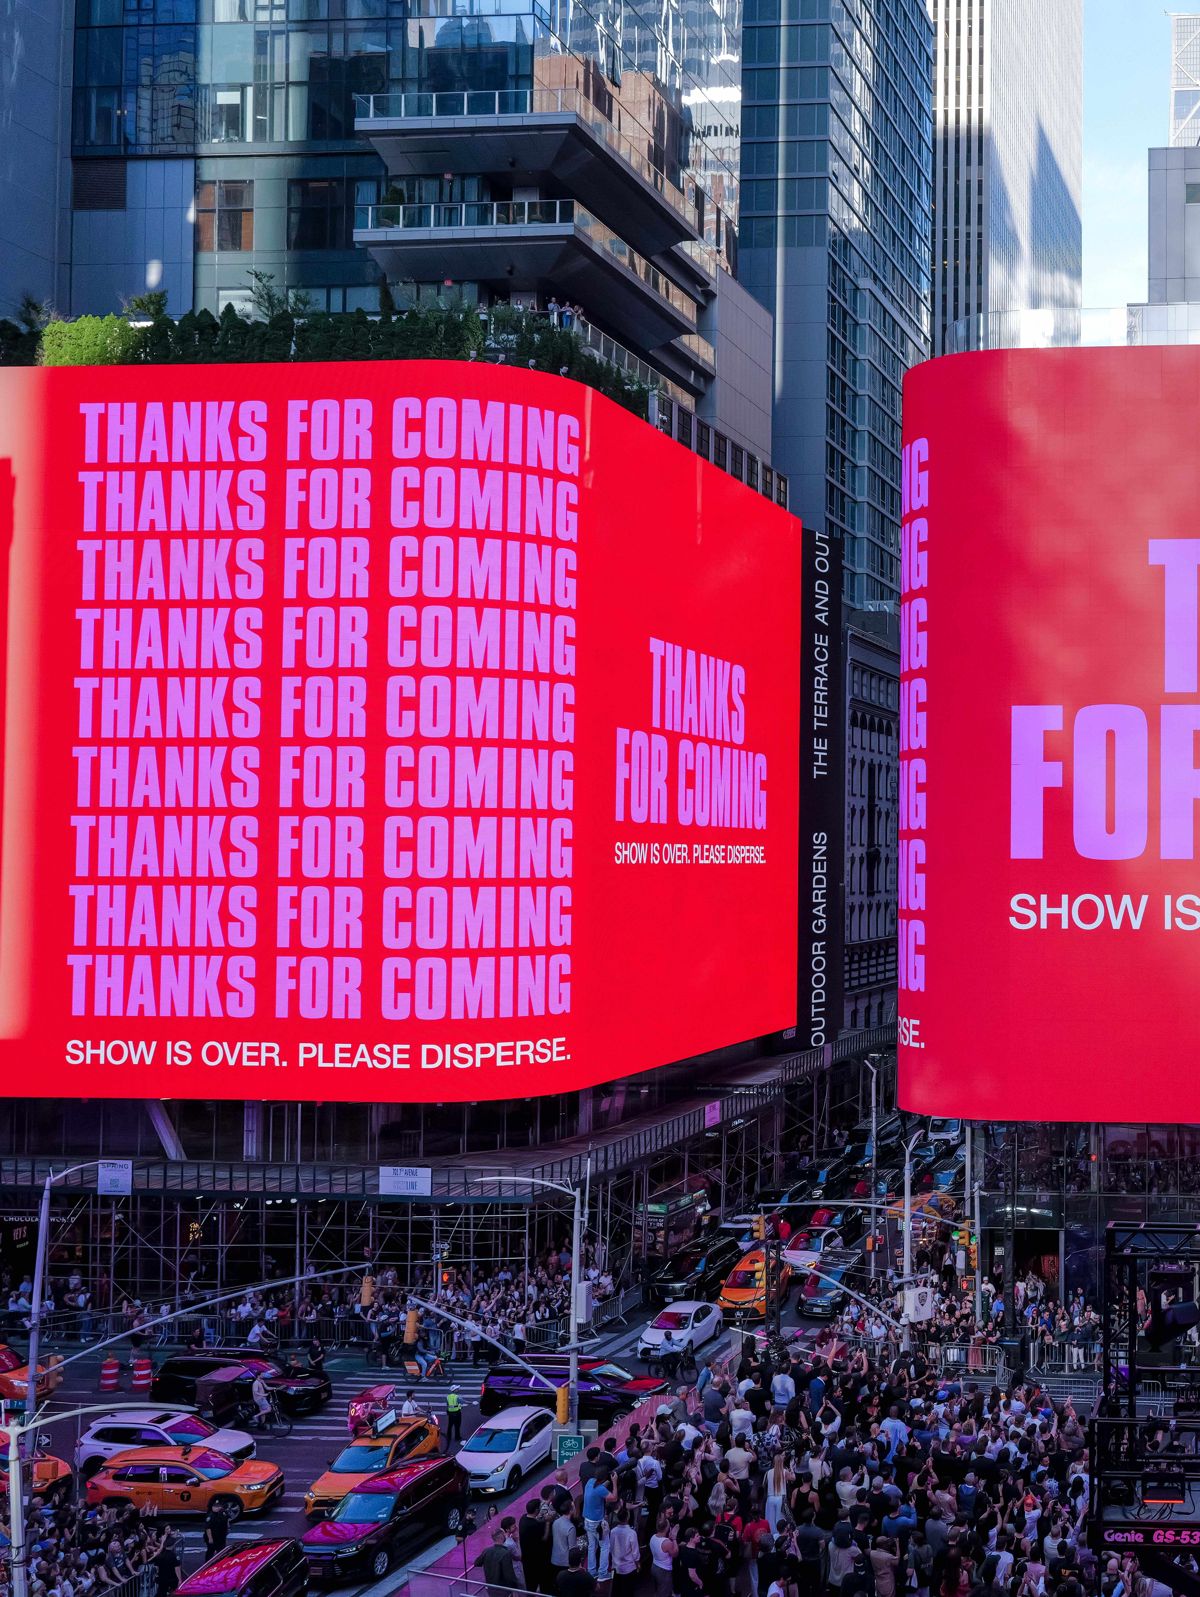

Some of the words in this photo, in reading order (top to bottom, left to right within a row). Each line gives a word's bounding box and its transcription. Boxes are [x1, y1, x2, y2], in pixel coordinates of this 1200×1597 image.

[80, 401, 267, 463] THANKS
[287, 399, 373, 460] FOR
[392, 397, 579, 476] COMING
[78, 469, 266, 532] THANKS
[285, 468, 371, 530] FOR
[391, 466, 578, 543] COMING
[77, 538, 264, 600] THANKS
[284, 537, 370, 598] FOR
[389, 536, 577, 609] COMING
[815, 579, 829, 626] AND
[76, 607, 263, 669] THANKS
[282, 606, 368, 668] FOR
[388, 605, 576, 676] COMING
[74, 677, 261, 738] THANKS
[281, 676, 367, 738] FOR
[386, 675, 575, 743] COMING
[650, 637, 746, 745] THANKS
[814, 633, 829, 730] TERRACE
[72, 746, 260, 808] THANKS
[279, 746, 365, 808] FOR
[385, 745, 574, 810] COMING
[615, 728, 669, 825] FOR
[677, 739, 768, 831] COMING
[814, 738, 828, 779] THE
[71, 816, 258, 877] THANKS
[278, 816, 364, 878] FOR
[384, 816, 573, 878] COMING
[615, 842, 648, 865] SHOW
[651, 843, 660, 865] IS
[663, 844, 690, 865] OVER.
[693, 844, 726, 865] PLEASE
[727, 845, 767, 865] DISPERSE.
[812, 831, 828, 934] GARDENS
[1008, 893, 1149, 931] SHOW
[69, 885, 257, 948] THANKS
[277, 886, 363, 948] FOR
[382, 886, 572, 949] COMING
[67, 954, 256, 1018] THANKS
[275, 956, 362, 1019] FOR
[382, 954, 571, 1020] COMING
[811, 941, 826, 1047] OUTDOOR
[66, 1040, 157, 1065] SHOW
[167, 1041, 192, 1065] IS
[202, 1041, 287, 1067] OVER.
[299, 1043, 410, 1069] PLEASE
[422, 1037, 571, 1069] DISPERSE.
[1104, 1528, 1144, 1543] Genie
